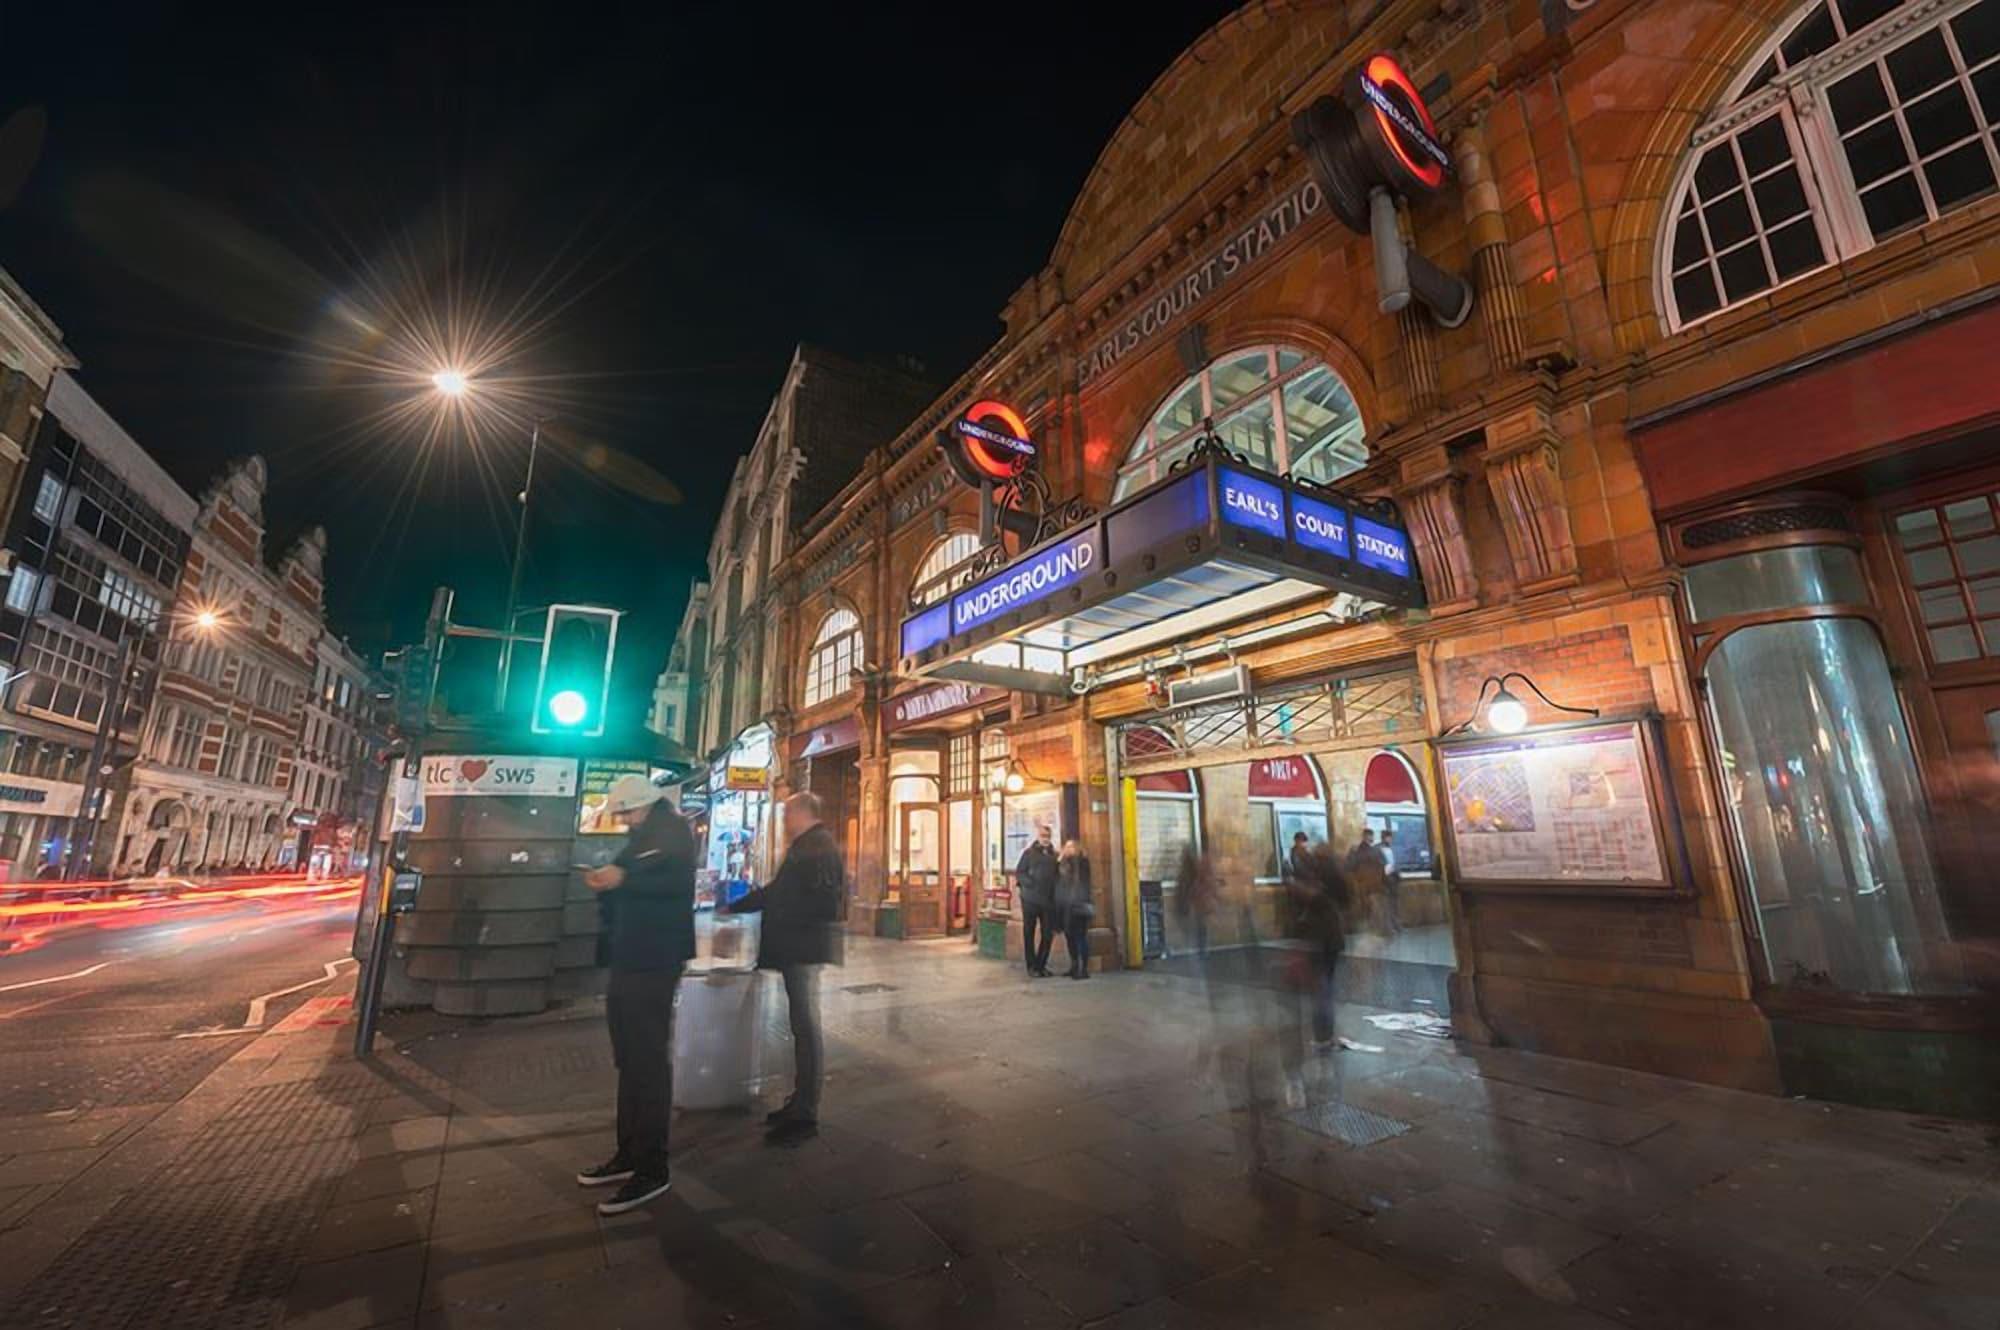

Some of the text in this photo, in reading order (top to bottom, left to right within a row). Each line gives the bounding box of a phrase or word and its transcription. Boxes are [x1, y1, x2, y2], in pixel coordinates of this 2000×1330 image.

[1361, 75, 1448, 166] UNDERGROUND
[1077, 180, 1323, 386] EARLS COURT STATIO
[959, 420, 1036, 455] UNDERGROUND
[1225, 487, 1406, 563] EARL'S COURT STATION
[956, 542, 1094, 626] UNDERGROUND
[426, 761, 537, 785] tlc SW5
